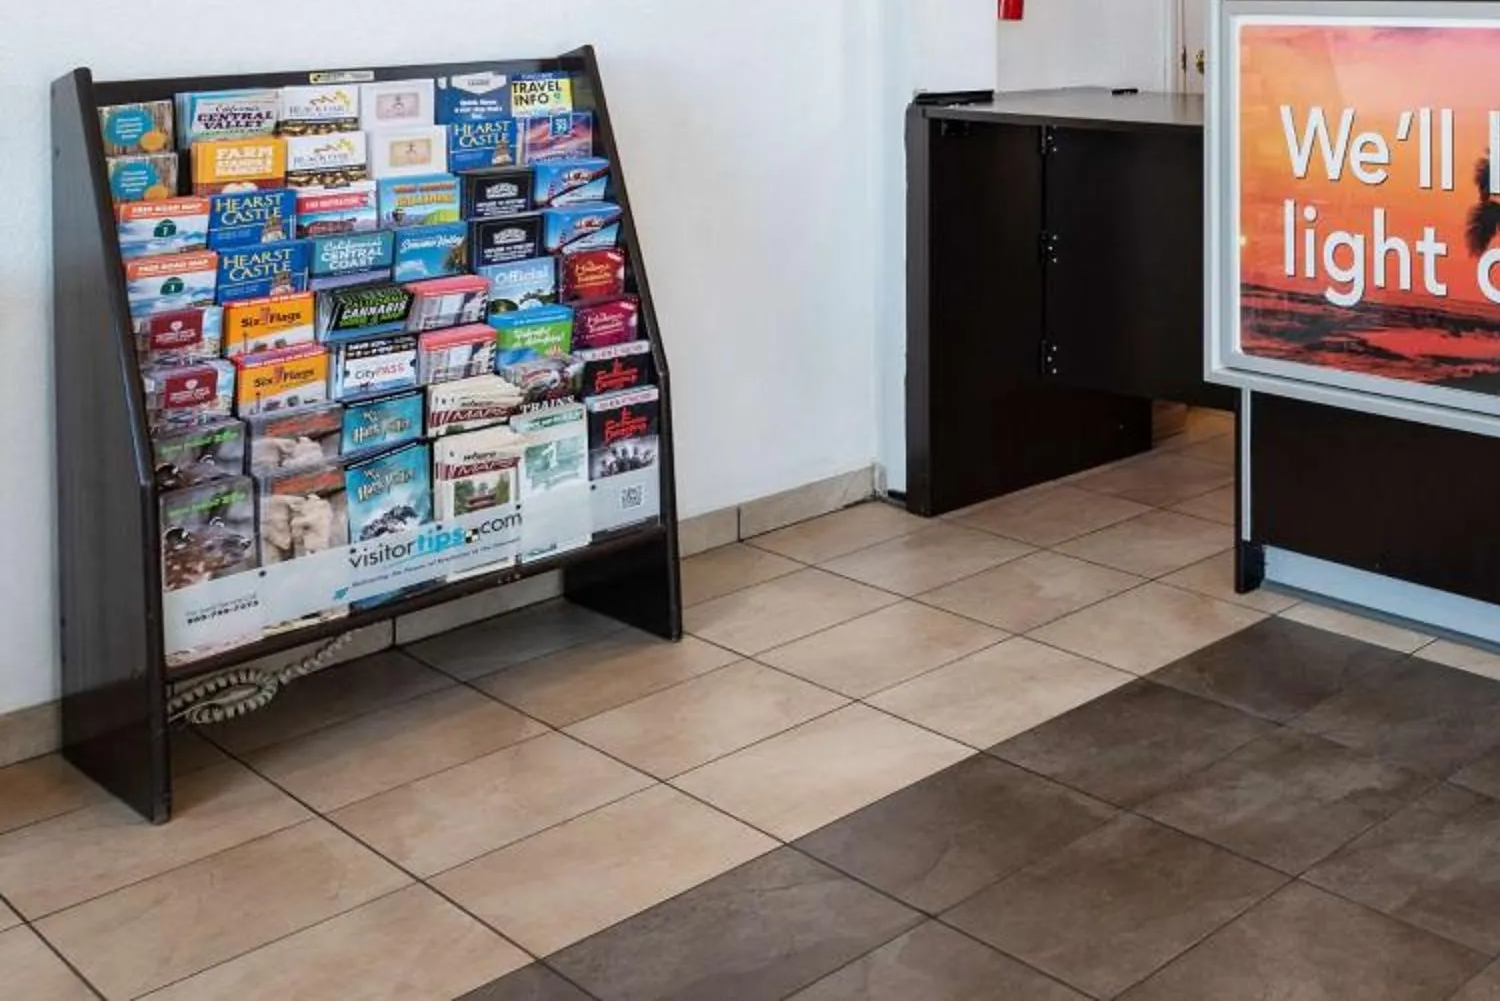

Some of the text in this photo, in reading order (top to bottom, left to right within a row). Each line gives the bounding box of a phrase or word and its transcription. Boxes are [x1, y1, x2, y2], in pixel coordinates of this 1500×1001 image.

[512, 80, 562, 94] TRAVEL
[514, 93, 549, 106] INFO
[198, 111, 273, 122] CENTRAL
[203, 120, 264, 130] VALLEY
[454, 120, 512, 136] HEARST
[459, 132, 510, 147] CASTLE
[1280, 104, 1454, 191] We'll
[216, 192, 285, 214] HEARST
[221, 207, 283, 226] CASTLE
[223, 249, 295, 270] HEARST
[321, 248, 383, 262] CENTRAL
[1283, 199, 1448, 307] light
[329, 257, 374, 270] COAST
[229, 263, 292, 281] CASTLE
[343, 301, 407, 319] CANNABIS
[241, 312, 302, 328] Six Flags
[254, 369, 314, 388] Six Flags
